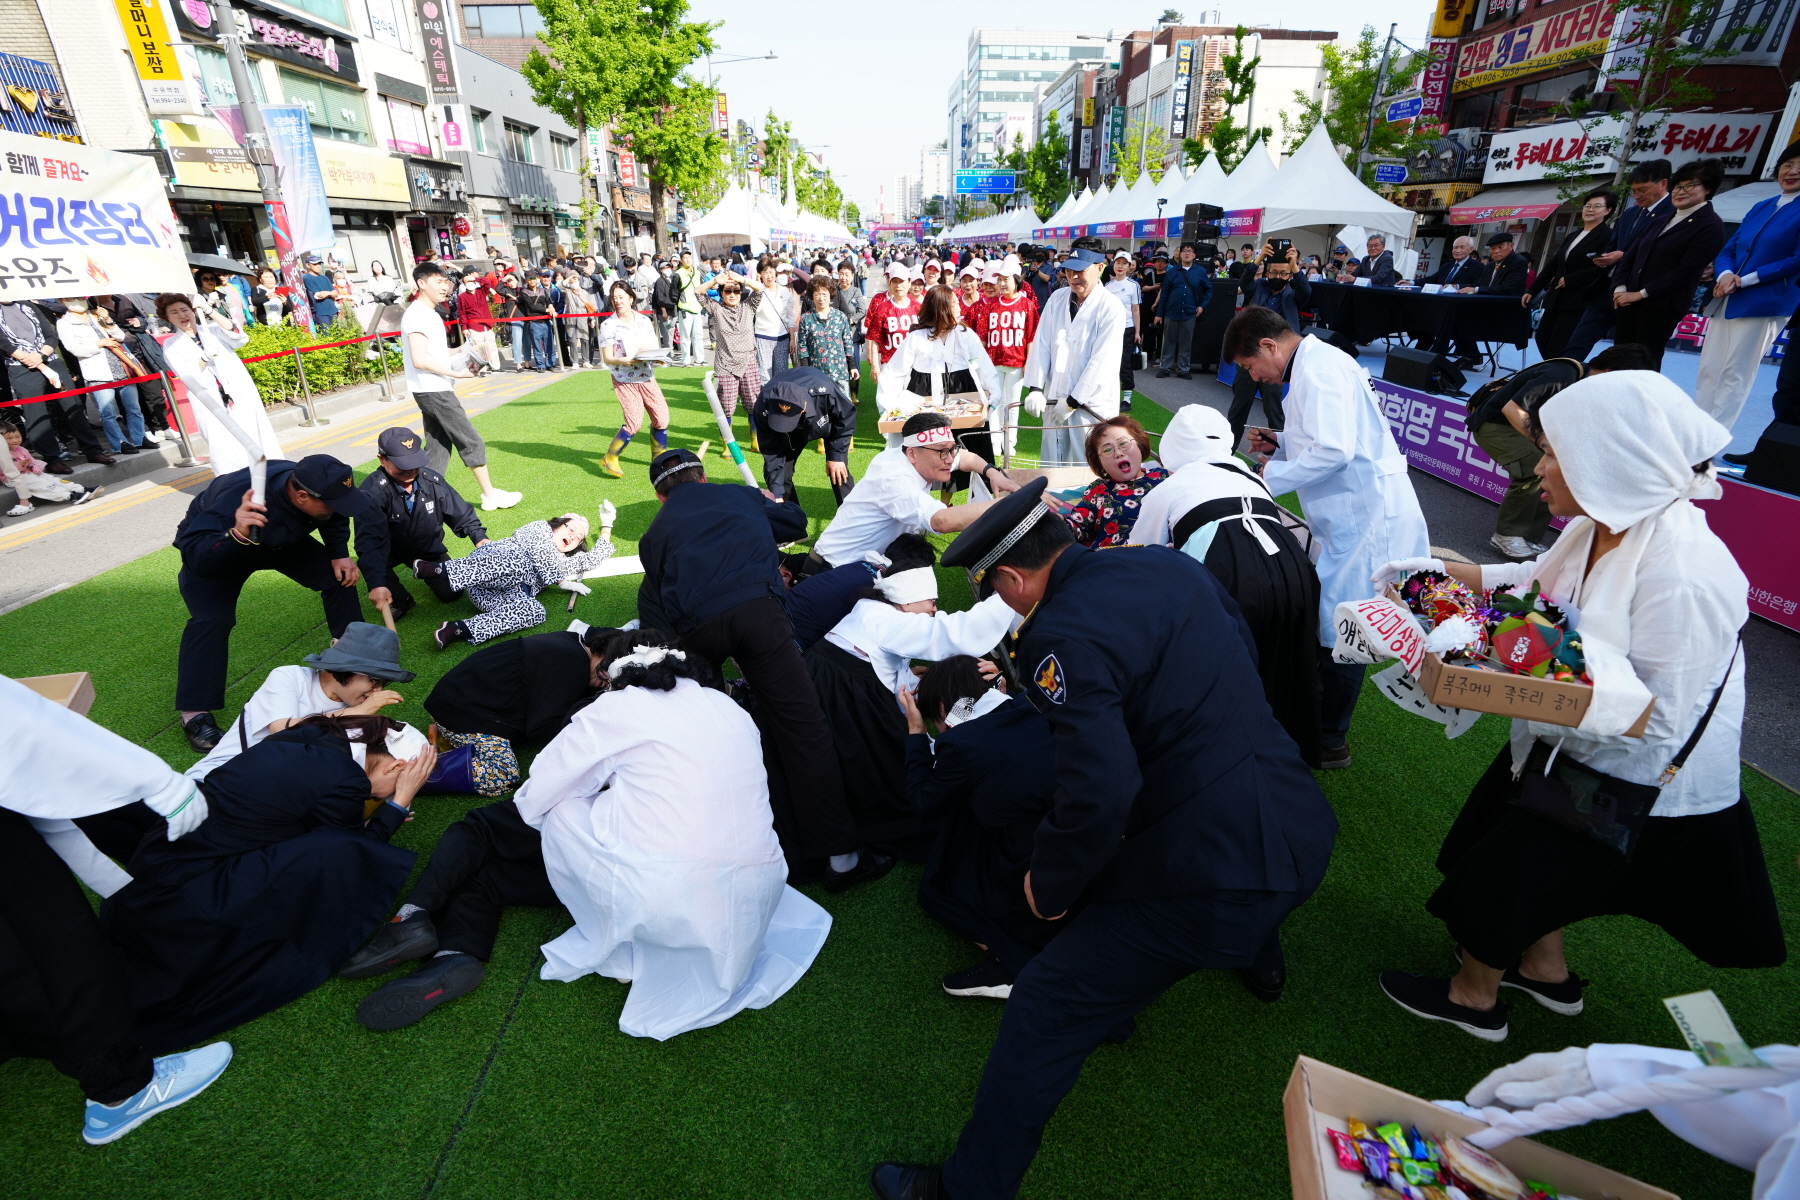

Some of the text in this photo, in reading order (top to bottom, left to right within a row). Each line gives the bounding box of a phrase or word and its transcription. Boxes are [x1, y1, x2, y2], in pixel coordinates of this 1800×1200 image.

[424, 21, 444, 35] 미원
[430, 37, 449, 85] 에스테틱
[447, 124, 458, 144] NAIL
[1661, 123, 1762, 155] 동태요리
[1513, 133, 1588, 170] 동태요리
[5, 152, 40, 176] 함께
[988, 311, 1026, 329] BON
[885, 334, 909, 350] JO
[1467, 473, 1481, 485] 후원
[1747, 586, 1798, 615] 신한은행
[1443, 673, 1579, 711] 복주머니 족두리 공기
